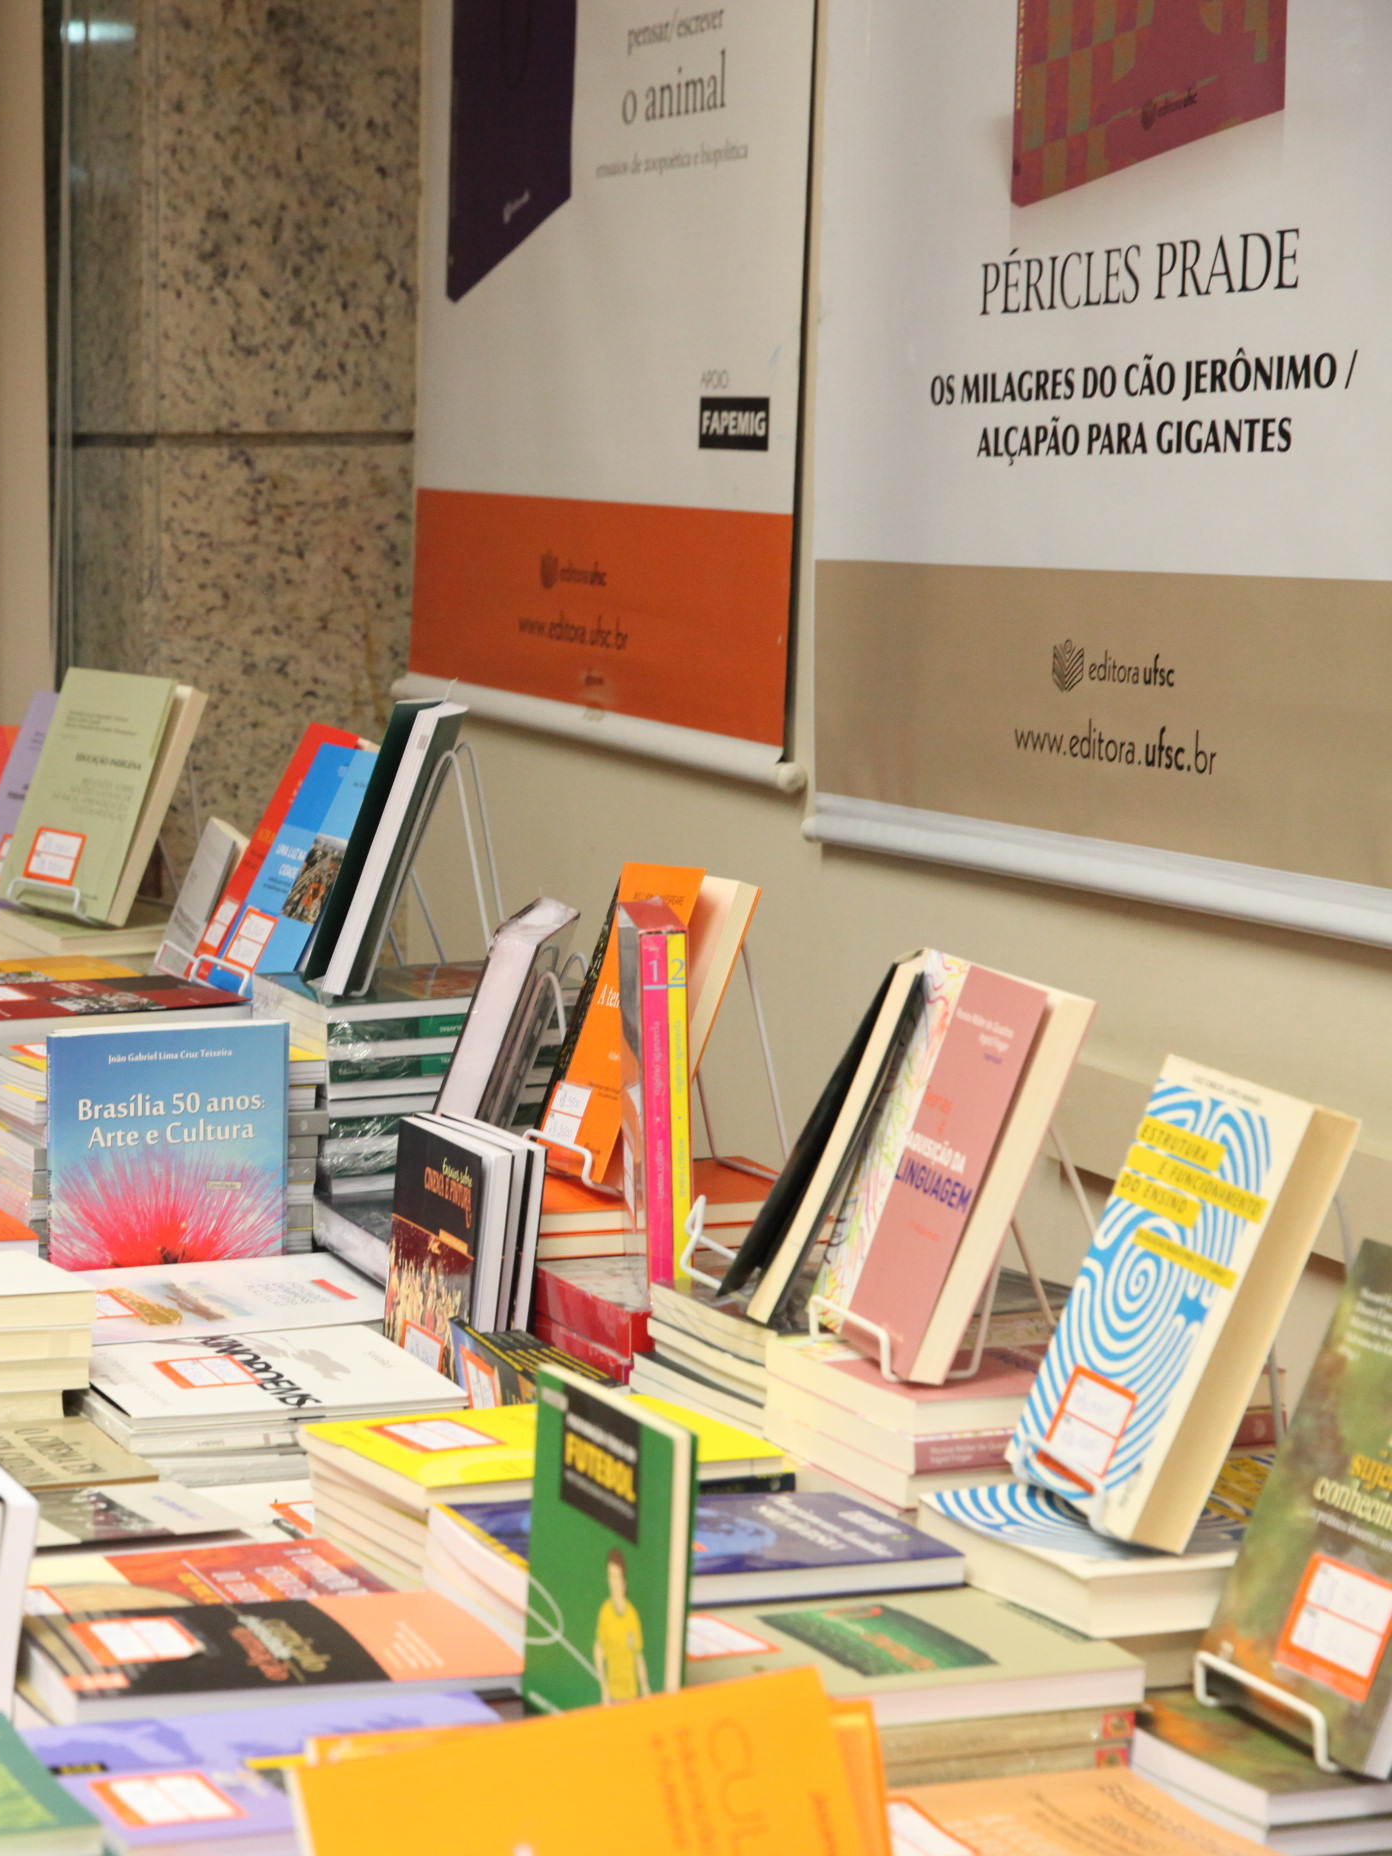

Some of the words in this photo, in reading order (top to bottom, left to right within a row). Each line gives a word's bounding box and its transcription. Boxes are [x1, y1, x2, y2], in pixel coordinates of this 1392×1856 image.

[627, 6, 724, 55] pensar/escrever
[622, 89, 637, 125] o
[644, 49, 727, 123] animal
[980, 247, 1141, 316] PÉRICLES
[1154, 228, 1301, 300] PRADE
[930, 374, 955, 406] OS
[961, 367, 1076, 405] MILAGRES
[1082, 365, 1117, 399] DO
[1124, 354, 1176, 397] CÃO
[1182, 347, 1338, 402] JERÔNIMO
[701, 409, 767, 438] FAPEMIG
[977, 416, 1080, 466] ALÇAPÃO
[1087, 421, 1148, 457] PARA
[1156, 416, 1293, 456] GIGANTES
[1088, 649, 1140, 685] editora
[1142, 653, 1175, 688] ufsc
[1014, 717, 1218, 776] www.editora.ufsc.br
[649, 959, 660, 983] 1
[670, 958, 686, 982] 2
[108, 1053, 127, 1065] João
[127, 1050, 158, 1063] Gabriel
[158, 1050, 179, 1061] Lima
[180, 1049, 199, 1060] Cruz
[200, 1048, 233, 1059] Teixeira
[77, 1093, 167, 1122] Brasília
[171, 1092, 201, 1115] 50
[206, 1093, 267, 1113] anos:
[87, 1125, 141, 1150] Arte
[145, 1129, 159, 1145] e
[164, 1118, 256, 1144] Cultura
[1140, 1123, 1209, 1163] ESTRUTURA
[895, 1153, 973, 1213] LINGUAGEM
[1119, 1173, 1140, 1194] DO
[1143, 1183, 1189, 1215] ENSINO
[1169, 1165, 1263, 1217] FUNCIONAMENTO
[564, 1431, 636, 1502] FUTEBOL
